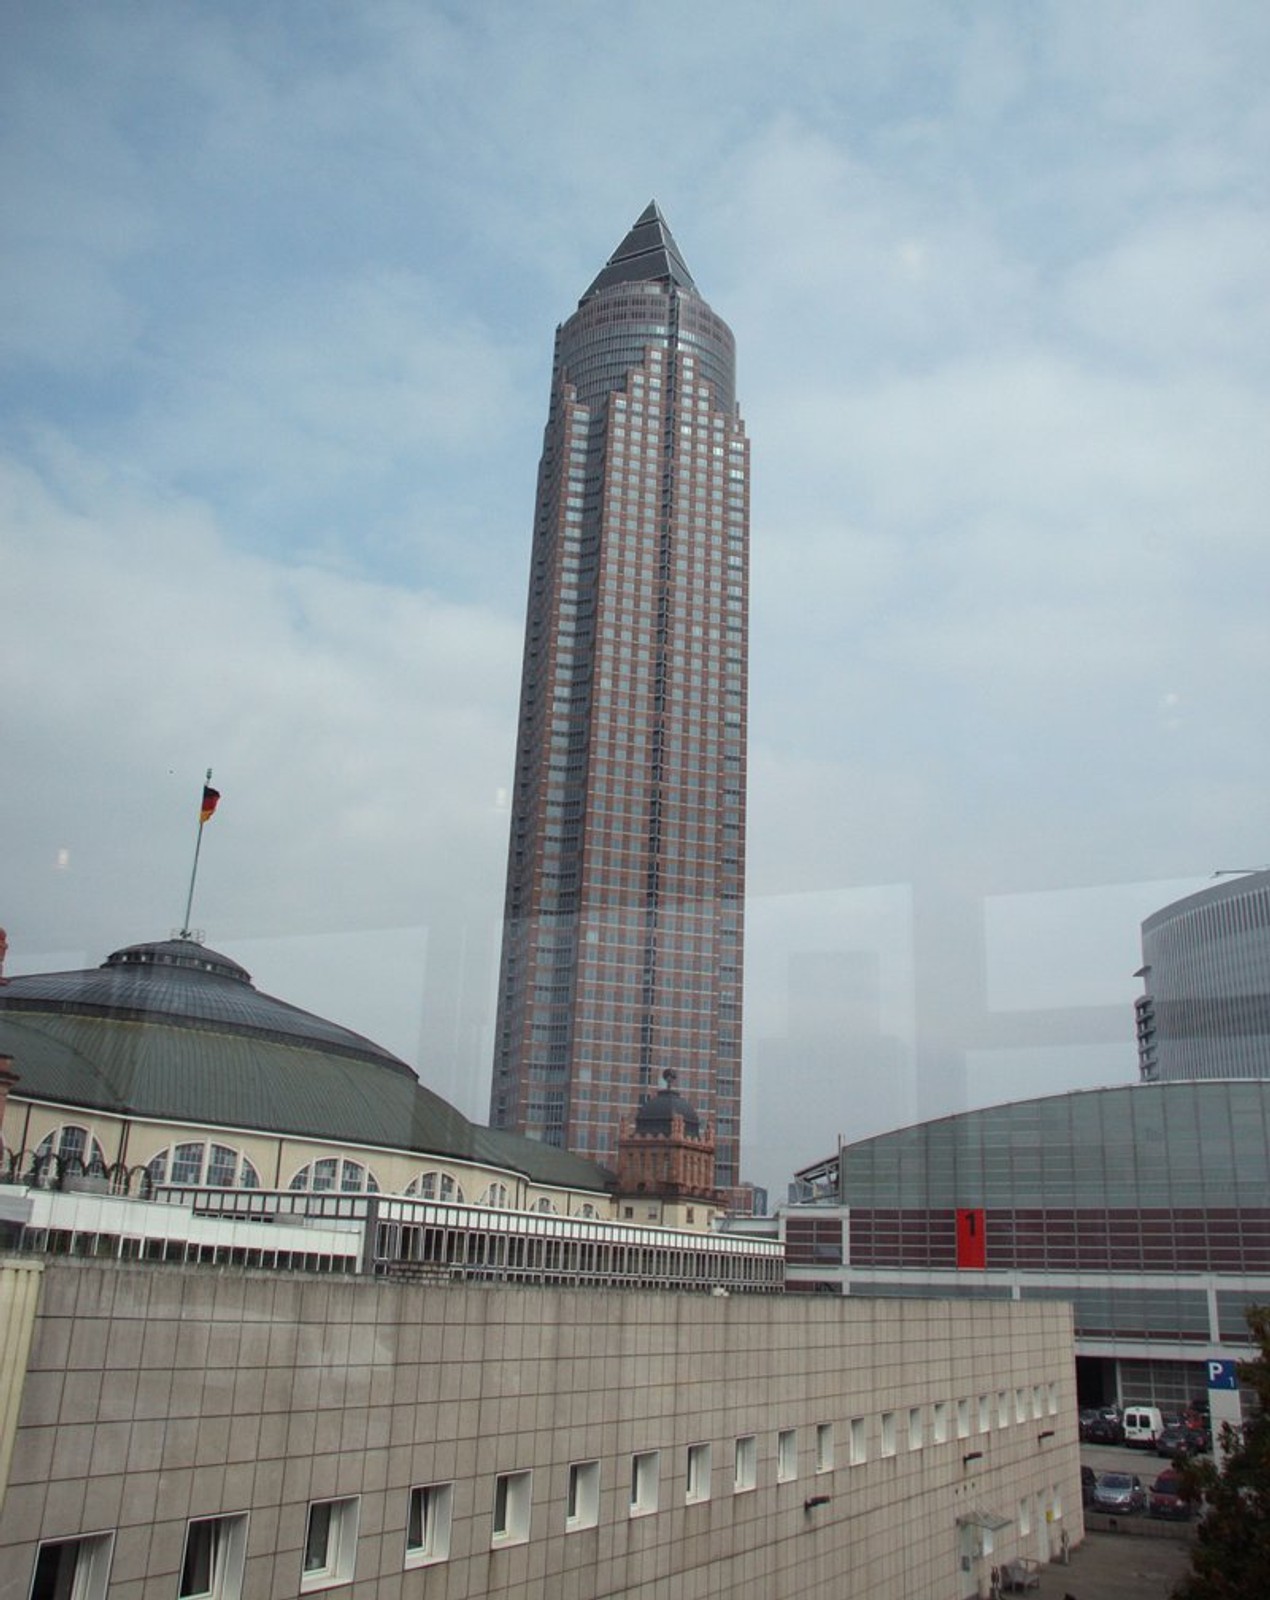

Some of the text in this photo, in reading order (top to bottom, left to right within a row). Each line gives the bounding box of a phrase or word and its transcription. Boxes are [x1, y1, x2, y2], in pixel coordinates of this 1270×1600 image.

[965, 1212, 976, 1237] 1
[1209, 1362, 1235, 1388] P 1
